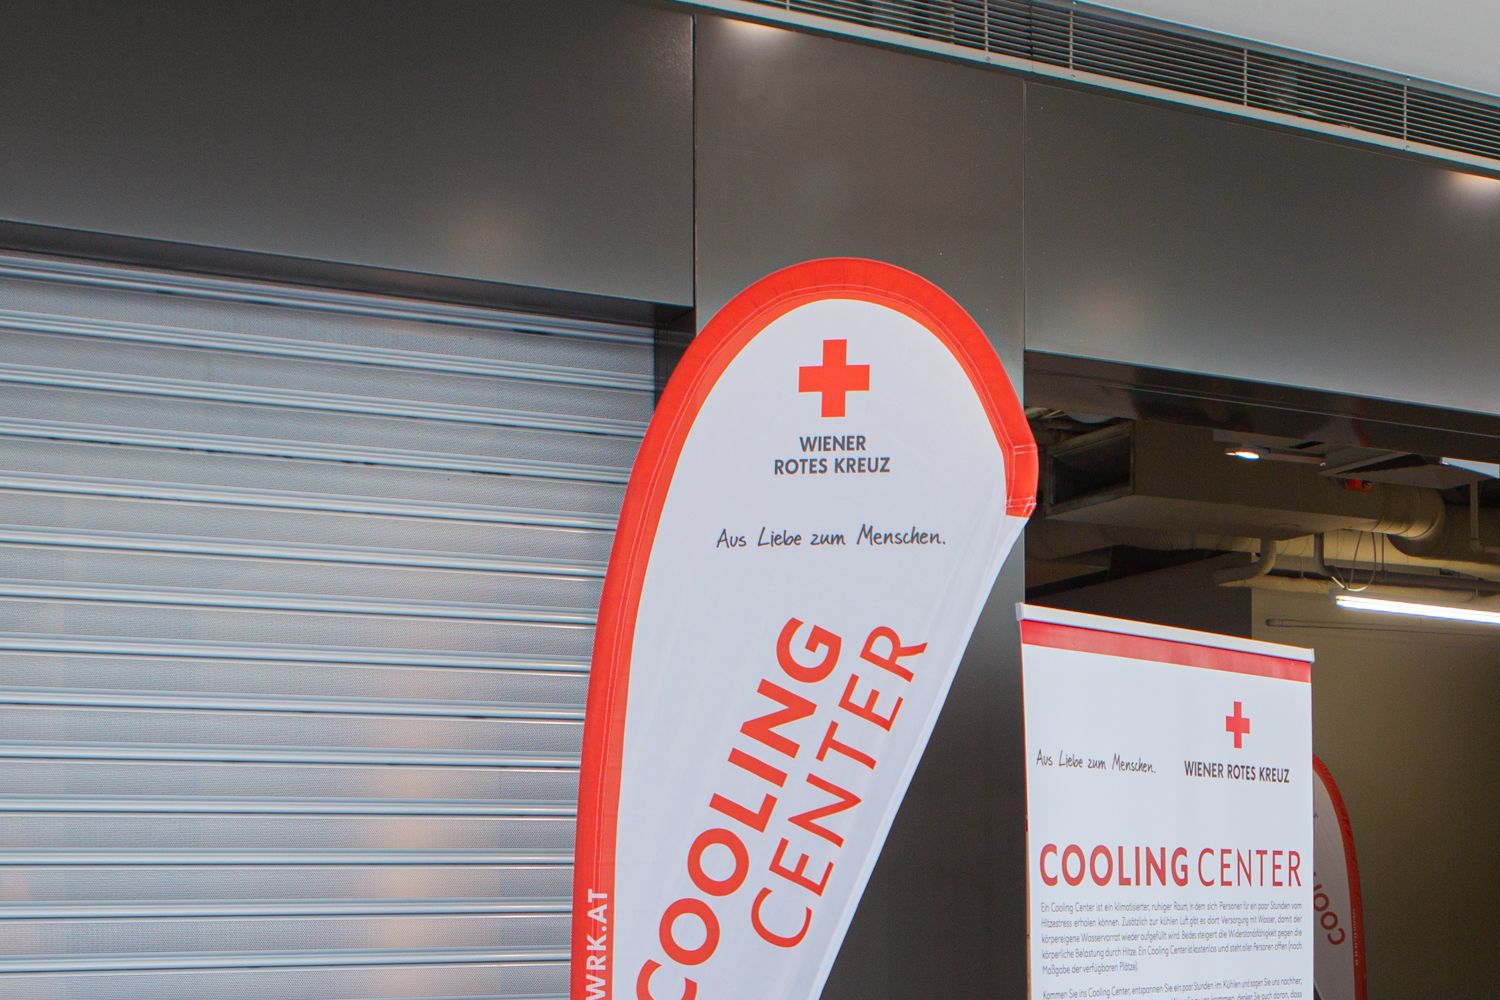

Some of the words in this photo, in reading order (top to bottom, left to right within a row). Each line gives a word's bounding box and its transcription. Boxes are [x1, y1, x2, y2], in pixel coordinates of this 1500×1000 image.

[800, 436, 866, 452] WIENER
[774, 458, 828, 475] ROTES
[834, 457, 890, 474] KREUZ
[716, 528, 747, 548] Aus
[758, 526, 801, 547] Liebe
[810, 532, 846, 546] zum
[856, 524, 946, 546] Menschen.
[1036, 749, 1053, 766] Aus
[1058, 750, 1084, 768] Liebe
[1088, 758, 1106, 770] zum
[1112, 753, 1156, 774] Menschen.
[1184, 760, 1224, 779] WIENER
[1227, 765, 1256, 780] ROTES
[1259, 766, 1290, 784] KREUZ
[751, 625, 928, 949] CENTER
[1040, 843, 1189, 887] COOLING
[1198, 848, 1302, 887] CENTER
[1051, 902, 1073, 914] Cooling
[1075, 902, 1094, 912] Center
[1088, 986, 1110, 999] Cooling
